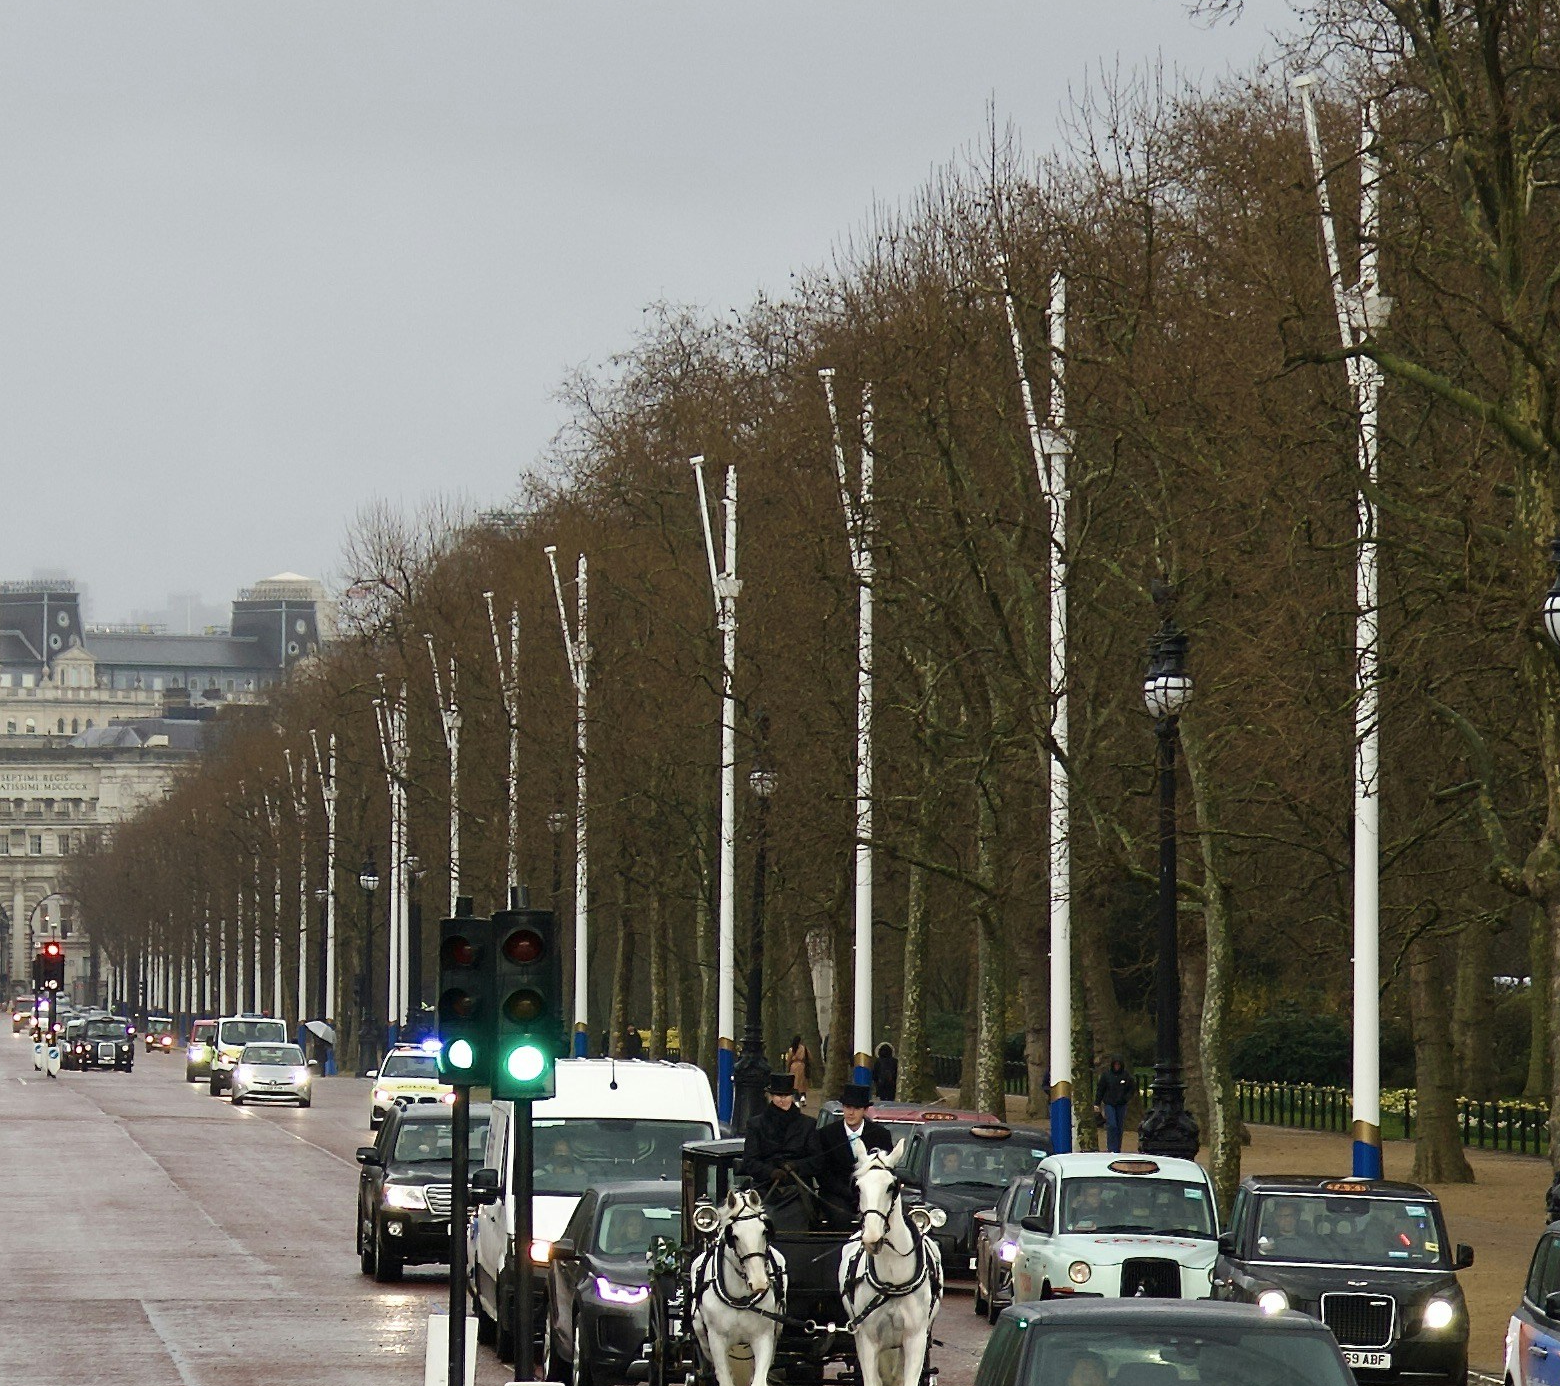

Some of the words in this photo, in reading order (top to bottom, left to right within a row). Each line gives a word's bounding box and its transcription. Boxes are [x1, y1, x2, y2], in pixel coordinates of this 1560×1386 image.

[0, 773, 39, 782] SEPTIMI
[42, 773, 70, 782] REGIS
[1362, 1354, 1386, 1366] ABF
